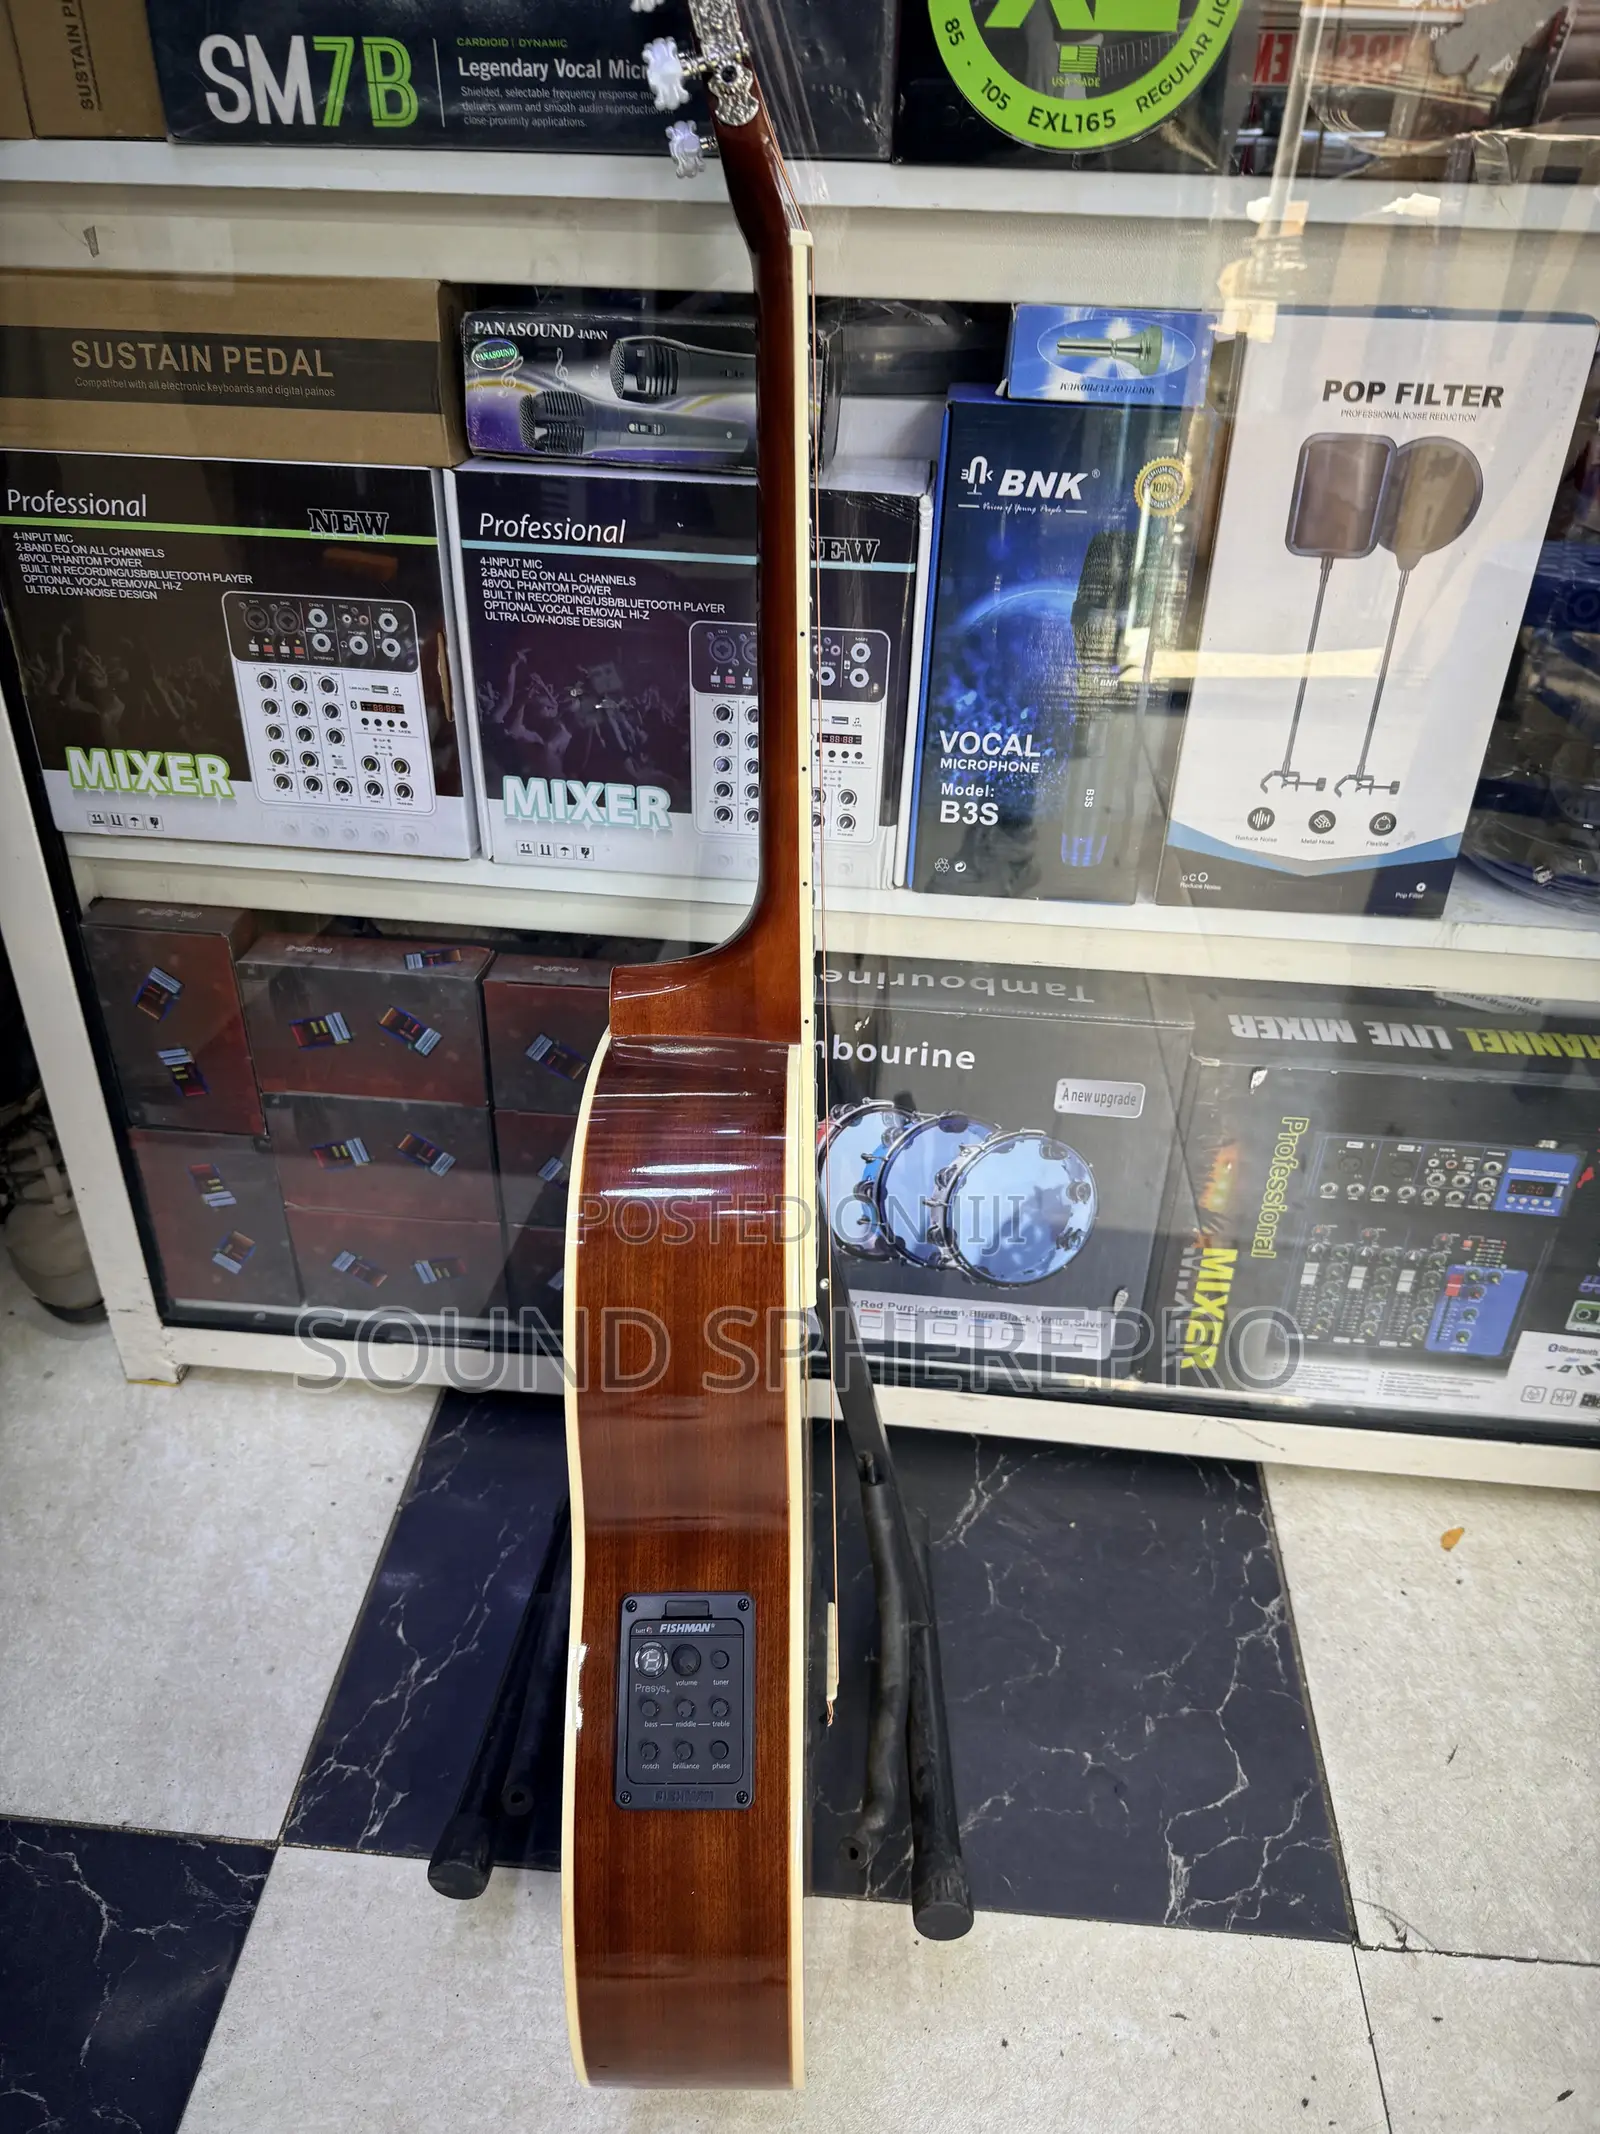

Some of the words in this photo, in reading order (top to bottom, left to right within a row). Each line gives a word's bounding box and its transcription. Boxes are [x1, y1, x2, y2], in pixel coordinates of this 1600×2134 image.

[944, 17, 965, 47] 85
[457, 38, 509, 47] CARDIOID
[519, 39, 568, 48] DYNAMIC
[65, 24, 94, 109] SUSTAIN
[458, 57, 548, 82] Legendary
[554, 58, 602, 79] Vocal
[1135, 31, 1214, 113] REGULAR
[199, 34, 419, 128] SM7B
[461, 86, 503, 99] Shielded,
[505, 87, 550, 99] selectable
[552, 88, 596, 101] frequency
[599, 90, 639, 102] response
[980, 76, 1012, 111] 105
[462, 101, 497, 112] delivers
[498, 103, 523, 112] warm
[525, 102, 543, 113] and
[544, 102, 577, 113] smooth
[579, 103, 602, 114] audio
[464, 115, 529, 128] close-proximity
[532, 115, 588, 129] applications.
[1027, 105, 1117, 133] EXL165
[473, 321, 575, 339] PANASOUND
[577, 328, 608, 340] JAPAN
[71, 340, 212, 373] SUSTAIN
[223, 346, 334, 378] PEDAL
[475, 347, 516, 362] PANASOUND
[128, 379, 147, 390] with
[148, 380, 160, 390] all
[161, 380, 206, 392] electronic
[207, 382, 255, 394] keyboards
[256, 384, 273, 395] and
[274, 385, 303, 397] digital
[1322, 379, 1386, 404] POP
[1395, 382, 1504, 408] FILTER
[1340, 408, 1401, 420] PROFESSIONAL
[1402, 411, 1427, 421] NOISE
[1428, 413, 1477, 423] REDUCTION
[998, 469, 1089, 500] BNK
[7, 489, 147, 517] Professional
[307, 508, 389, 540] NEW
[479, 512, 627, 544] Professional
[13, 532, 52, 543] 4-INPUT
[54, 533, 73, 543] MIC
[15, 543, 53, 553] 2-BAND
[55, 544, 70, 554] EQ
[72, 545, 88, 555] ON
[90, 545, 108, 556] ALL
[109, 547, 165, 559] CHANNELS
[18, 554, 50, 565] 48VOL
[51, 555, 102, 567] PHANTOM
[104, 557, 143, 568] POWER
[480, 557, 521, 568] 4-INPUT
[522, 558, 543, 569] MIC
[20, 564, 49, 574] BUILT
[51, 565, 61, 575] IN
[63, 566, 211, 582] RECORDING/USB/BLUETOOTH
[213, 573, 253, 584] PLAYER
[23, 575, 74, 587] OPTIONAL
[75, 576, 109, 588] VOCAL
[111, 578, 160, 590] REMOVAL
[162, 581, 183, 592] HI-Z
[481, 568, 520, 579] 2-BAND
[522, 569, 537, 581] EQ
[539, 570, 556, 582] ON
[558, 571, 577, 583] ALL
[579, 573, 637, 587] CHANNELS
[25, 585, 60, 596] ULTRA
[60, 586, 118, 598] LOW-NOISE
[119, 588, 158, 600] DESIGN
[482, 579, 515, 591] 48VOL
[517, 581, 570, 594] PHANTOM
[572, 584, 611, 596] POWER
[483, 589, 513, 601] BUILT
[515, 591, 525, 601] IN
[527, 592, 681, 611] RECORDING/USB/BLUETOOTH
[683, 602, 725, 614] PLAYER
[484, 600, 537, 613] OPTIONAL
[538, 603, 574, 615] VOCAL
[576, 606, 627, 619] REMOVAL
[629, 609, 650, 621] HI-Z
[485, 611, 520, 623] ULTRA
[521, 613, 581, 627] LOW-NOISE
[583, 617, 622, 630] DESIGN
[939, 730, 1041, 757] VOCAL
[64, 745, 235, 798] MIXER
[940, 758, 1040, 774] MICROPHONE
[941, 782, 995, 797] Model:
[1084, 788, 1095, 808] B3S
[502, 775, 672, 828] MIXER
[940, 800, 999, 826] B3S
[819, 968, 1095, 1003] Tambourine
[1228, 1014, 1358, 1044] MIXER
[1363, 1020, 1453, 1050] LIVE
[1062, 1087, 1071, 1102] A
[1072, 1091, 1093, 1103] new
[1094, 1090, 1137, 1108] upgrade
[1251, 1115, 1310, 1260] Professional
[1181, 1248, 1238, 1370] MIXER
[660, 1623, 711, 1634] FISHMAN
[675, 1679, 698, 1687] volume
[644, 1720, 659, 1728] bass
[675, 1720, 697, 1728] middle
[712, 1720, 731, 1728] treble
[641, 1762, 660, 1770] notch
[672, 1762, 700, 1770] brilliance
[712, 1762, 731, 1771] phase
